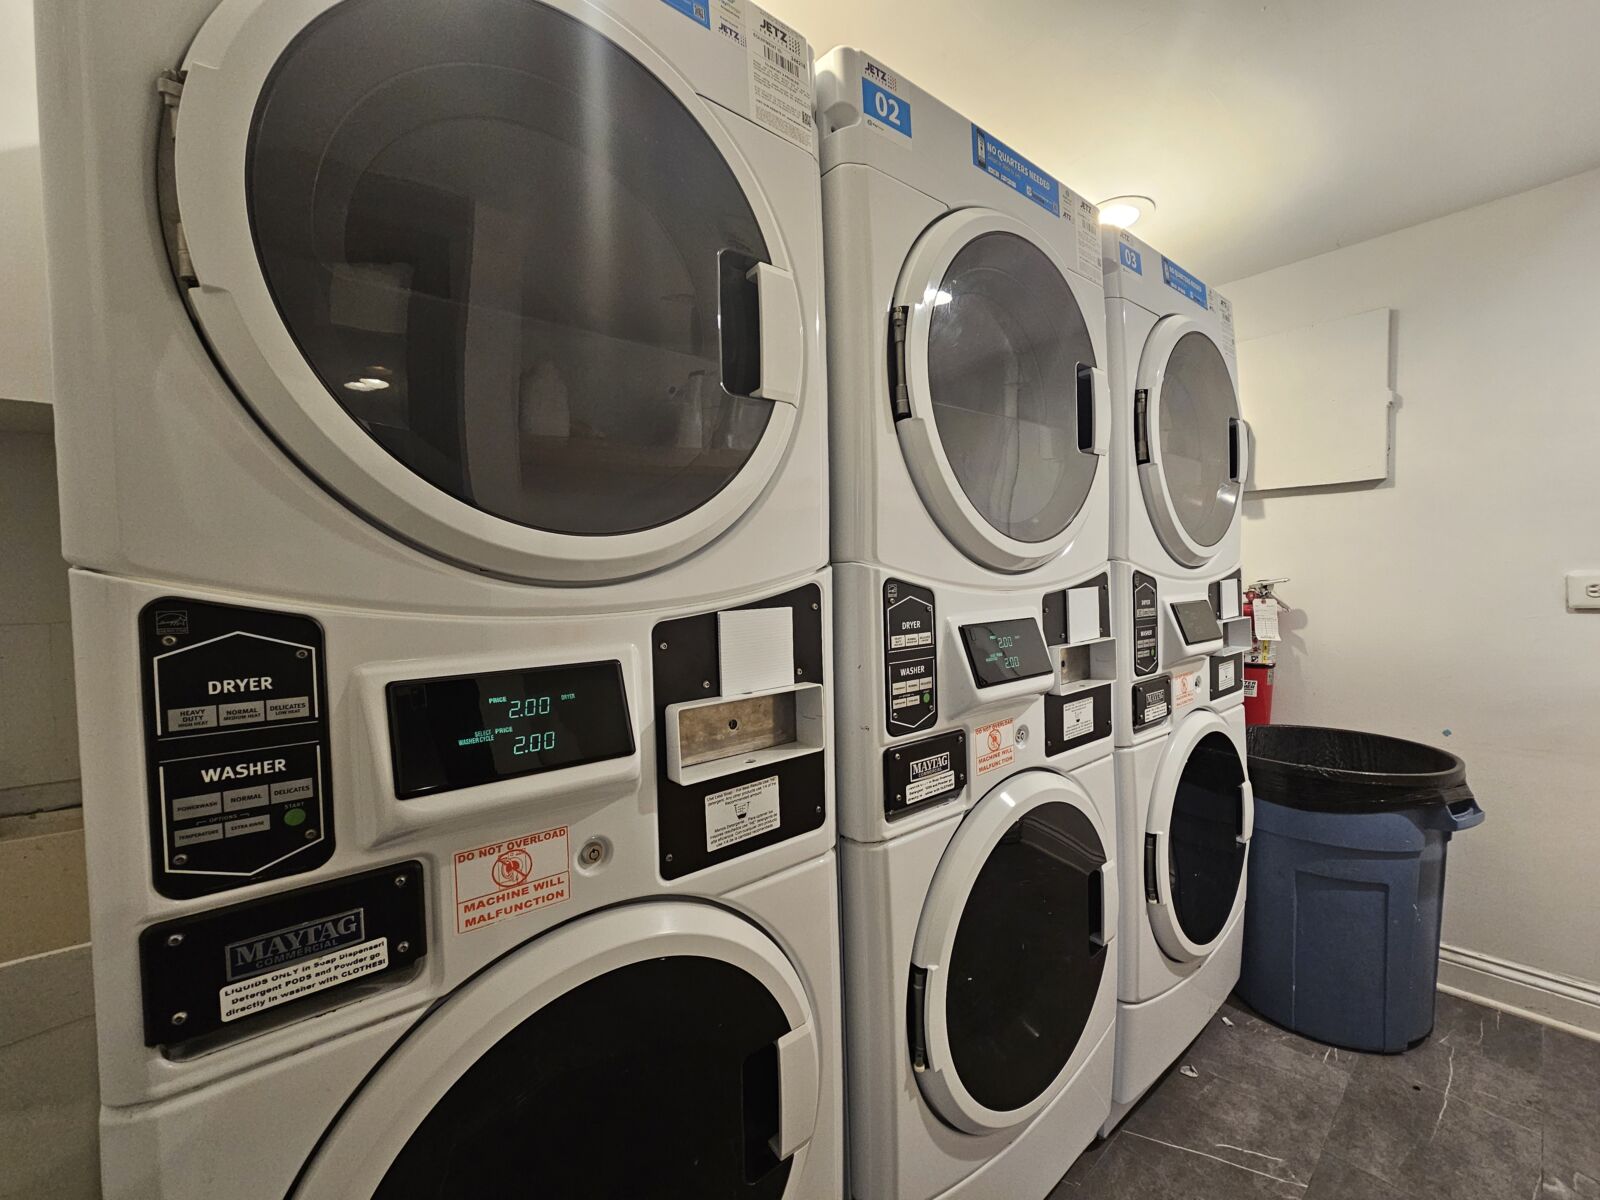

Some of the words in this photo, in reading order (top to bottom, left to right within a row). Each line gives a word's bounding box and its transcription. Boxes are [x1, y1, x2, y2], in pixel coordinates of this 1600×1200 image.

[718, 23, 739, 41] JETZ
[760, 19, 787, 43] JETZ
[865, 62, 887, 81] JETZ
[875, 91, 900, 126] 02
[987, 142, 996, 155] NO
[998, 150, 1029, 177] QUARTERS
[1029, 170, 1050, 191] NEEDED
[1125, 249, 1137, 268] 03
[902, 620, 921, 630] DRYER
[900, 665, 925, 677] WASHER
[208, 676, 273, 695] DRYER
[180, 708, 206, 717] HEAVY
[226, 707, 258, 716] NORMAL
[269, 702, 306, 712] DELICATES
[488, 696, 507, 704] PRICE
[508, 696, 550, 719] 2.00
[182, 715, 203, 723] DUTY
[495, 726, 513, 734] PRICE
[513, 731, 555, 755] 2.00
[912, 755, 948, 776] MAYTAG
[979, 752, 1001, 764] MACHINE
[1002, 748, 1013, 757] WILL
[979, 756, 1013, 772] MALFUNCTION
[201, 758, 287, 783] WASHER
[230, 793, 262, 803] NORMAL
[273, 785, 311, 796] DELICATES
[284, 801, 305, 809] START
[209, 813, 238, 823] OPTIONS
[458, 854, 475, 864] DO
[480, 845, 503, 858] NOT
[507, 828, 566, 851] OVERLOAD
[464, 886, 529, 914] MACHINE
[533, 876, 565, 892] WILL
[465, 889, 564, 928] MALFUNCTION
[235, 915, 358, 967] MAYTAG
[255, 939, 339, 969] COMMERCIAL
[224, 977, 268, 997] LIQUIDS
[271, 967, 300, 982] ONLY
[301, 964, 311, 973] in
[313, 956, 337, 969] Soap
[339, 941, 385, 961] Dispenser!
[225, 999, 266, 1017] directly
[268, 995, 278, 1003] in
[280, 982, 316, 998] washer
[318, 974, 339, 986] with
[341, 959, 386, 978] CLOTHES!
[231, 984, 282, 1006] Detergent
[285, 973, 312, 987] PODS
[314, 967, 332, 978] and
[334, 955, 368, 971] Powder
[369, 952, 381, 963] go
